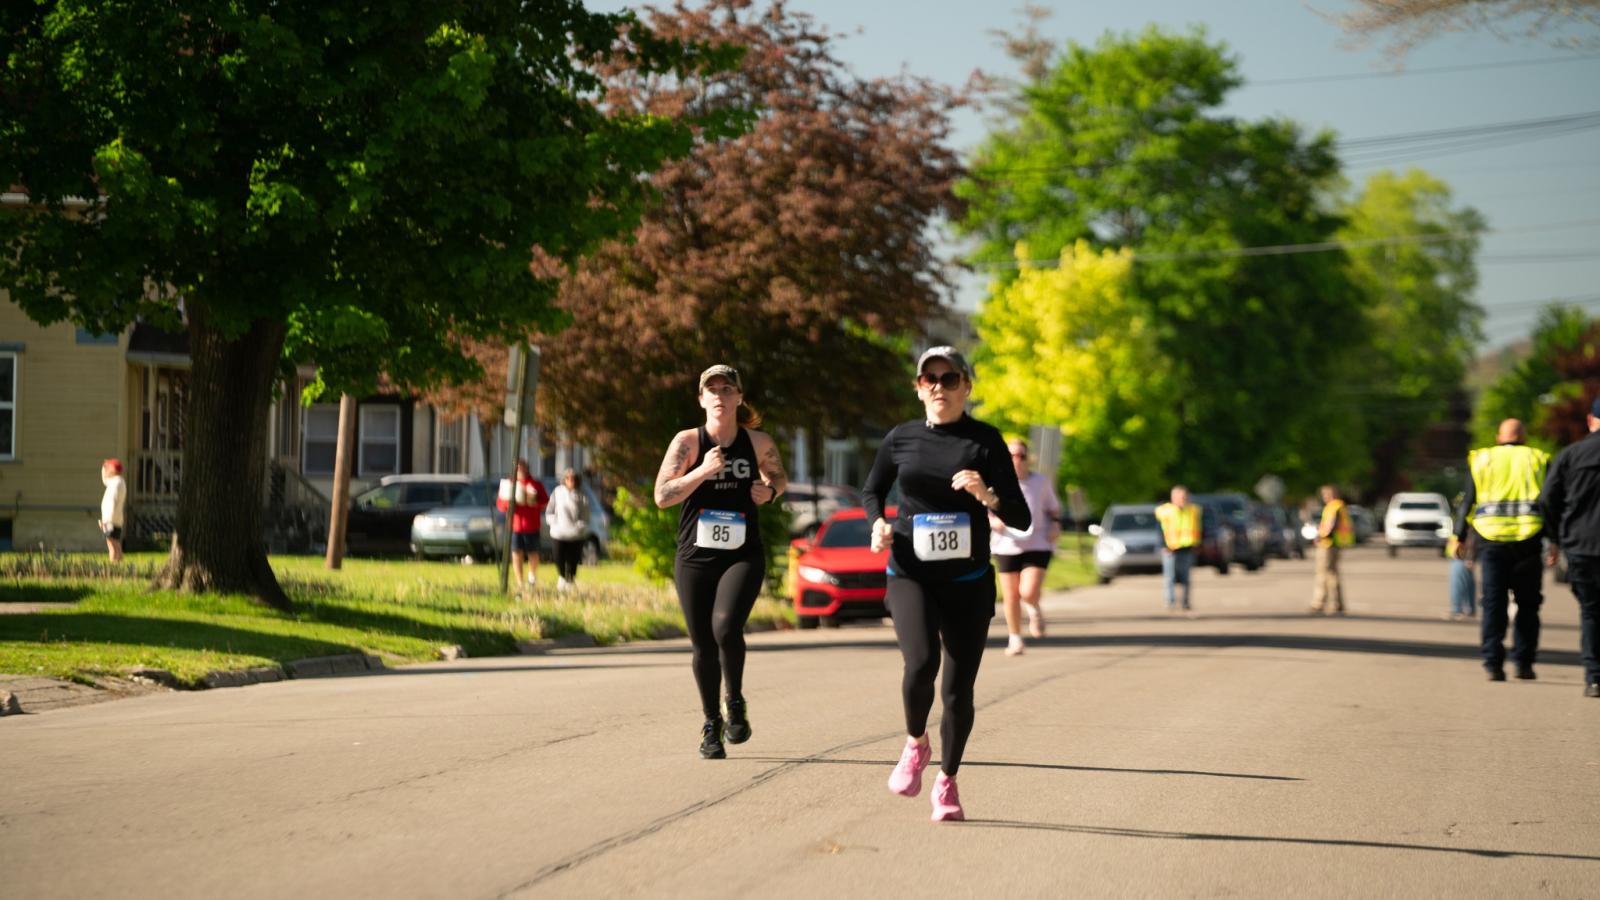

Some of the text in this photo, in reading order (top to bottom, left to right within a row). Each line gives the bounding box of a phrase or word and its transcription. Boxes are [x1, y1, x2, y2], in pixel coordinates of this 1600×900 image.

[705, 458, 750, 480] FG
[712, 524, 730, 542] 85
[929, 530, 958, 551] 138
